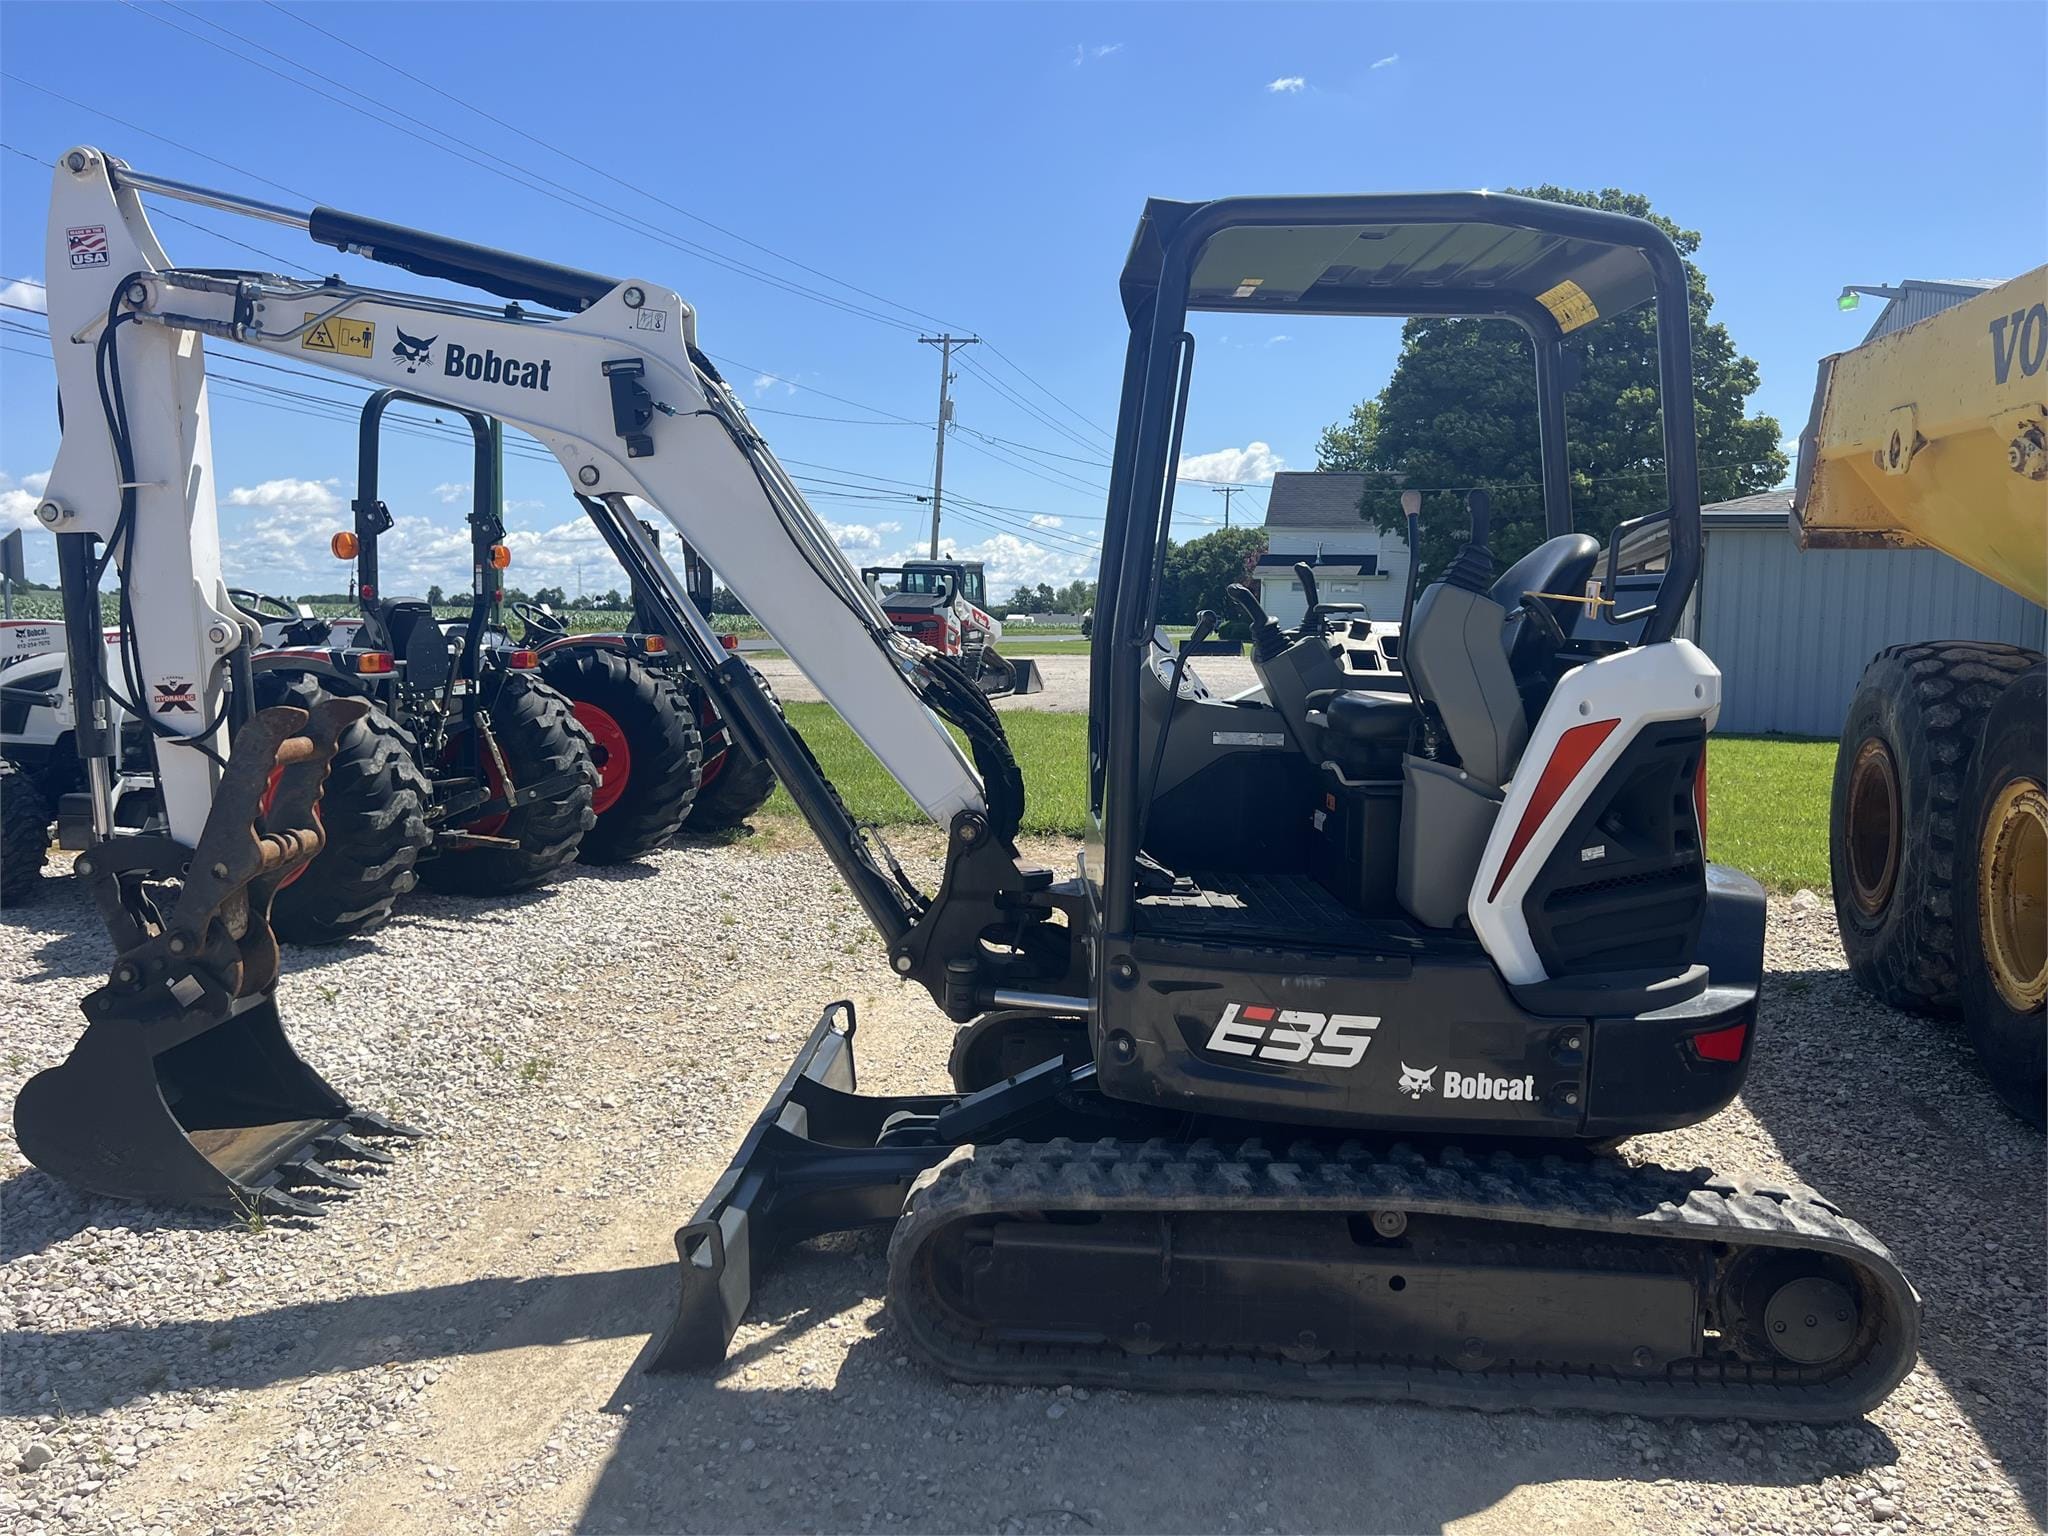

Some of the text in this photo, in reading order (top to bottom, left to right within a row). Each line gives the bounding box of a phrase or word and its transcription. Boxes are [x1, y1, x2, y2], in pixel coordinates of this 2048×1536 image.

[72, 253, 106, 264] USA
[1989, 303, 2048, 385] VO
[444, 343, 551, 391] Bobcat
[27, 628, 47, 637] Bobcat
[155, 694, 195, 702] HYDRAULIC
[1206, 1003, 1381, 1068] E35
[1443, 1071, 1536, 1101] Bobcat
